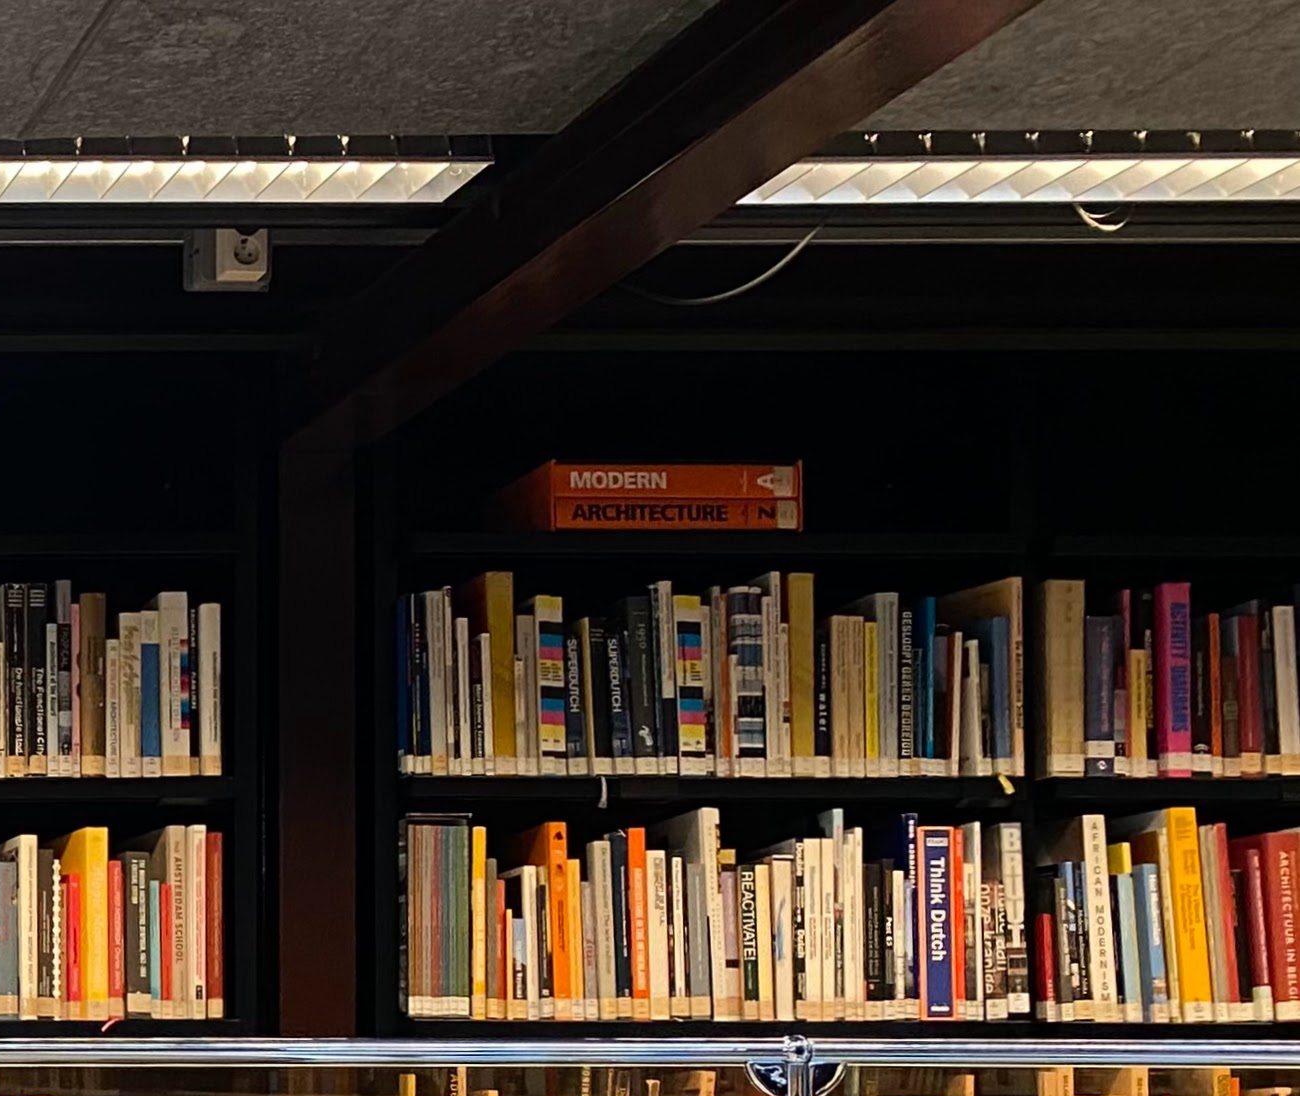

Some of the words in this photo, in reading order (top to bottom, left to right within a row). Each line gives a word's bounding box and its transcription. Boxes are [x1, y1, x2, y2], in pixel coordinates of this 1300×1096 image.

[569, 470, 667, 490] MODERN
[571, 503, 729, 523] ARCHITECTURE
[635, 623, 647, 649] 1950
[902, 611, 913, 664] GESLOOPT
[35, 667, 45, 684] The
[567, 638, 581, 713] SUPERDUTCH
[608, 638, 623, 713] SUPERDUTCH
[902, 667, 913, 702] GERED
[35, 686, 45, 735] Functional
[818, 692, 828, 732] water
[902, 704, 913, 757] BEDREIGD
[35, 737, 45, 755] City
[795, 841, 805, 877] Double
[929, 856, 947, 905] Think
[1091, 822, 1104, 898] AFRICAN
[174, 857, 184, 921] AMSTERDAM
[980, 884, 994, 925] onze
[1279, 851, 1296, 945] ARCHITECTUUR
[741, 870, 757, 961] REACTIVATE!
[886, 916, 894, 936] Post
[930, 908, 951, 962] Dutch
[174, 923, 184, 966] SCHOOL
[796, 928, 806, 959] Dutch
[886, 936, 894, 948] 65
[983, 930, 998, 995] kranige
[1095, 904, 1112, 1002] MODERNISM
[1286, 948, 1296, 962] IN
